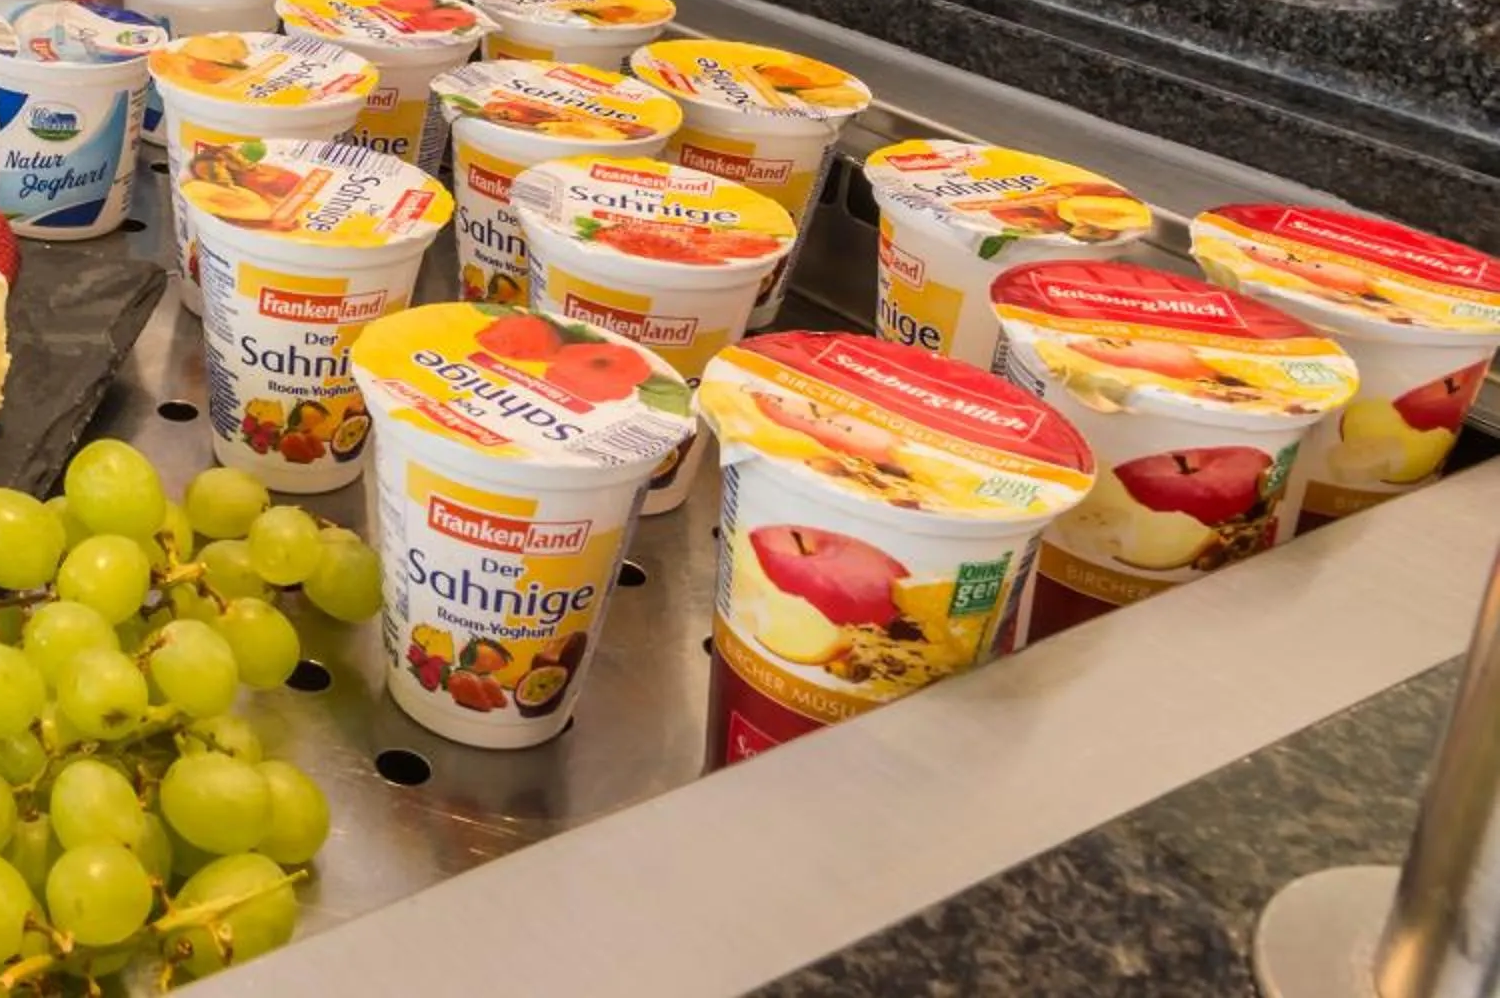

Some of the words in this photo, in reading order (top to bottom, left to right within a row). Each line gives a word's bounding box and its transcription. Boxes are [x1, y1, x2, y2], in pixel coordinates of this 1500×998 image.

[5, 150, 66, 170] Natur
[19, 159, 108, 200] Joghurt
[684, 149, 787, 181] Frankenland
[497, 209, 518, 226] De
[569, 185, 738, 224] Sahnige
[460, 205, 525, 257] Sahn
[262, 292, 382, 319] Frankenland
[568, 300, 688, 340] Frankenland
[881, 297, 941, 351] nige
[241, 335, 350, 378] Sahni
[304, 332, 338, 346] Der
[414, 350, 584, 441] Sahnige
[432, 503, 583, 550] Frankenland
[409, 548, 594, 625] Sahnige
[481, 557, 525, 579] Der
